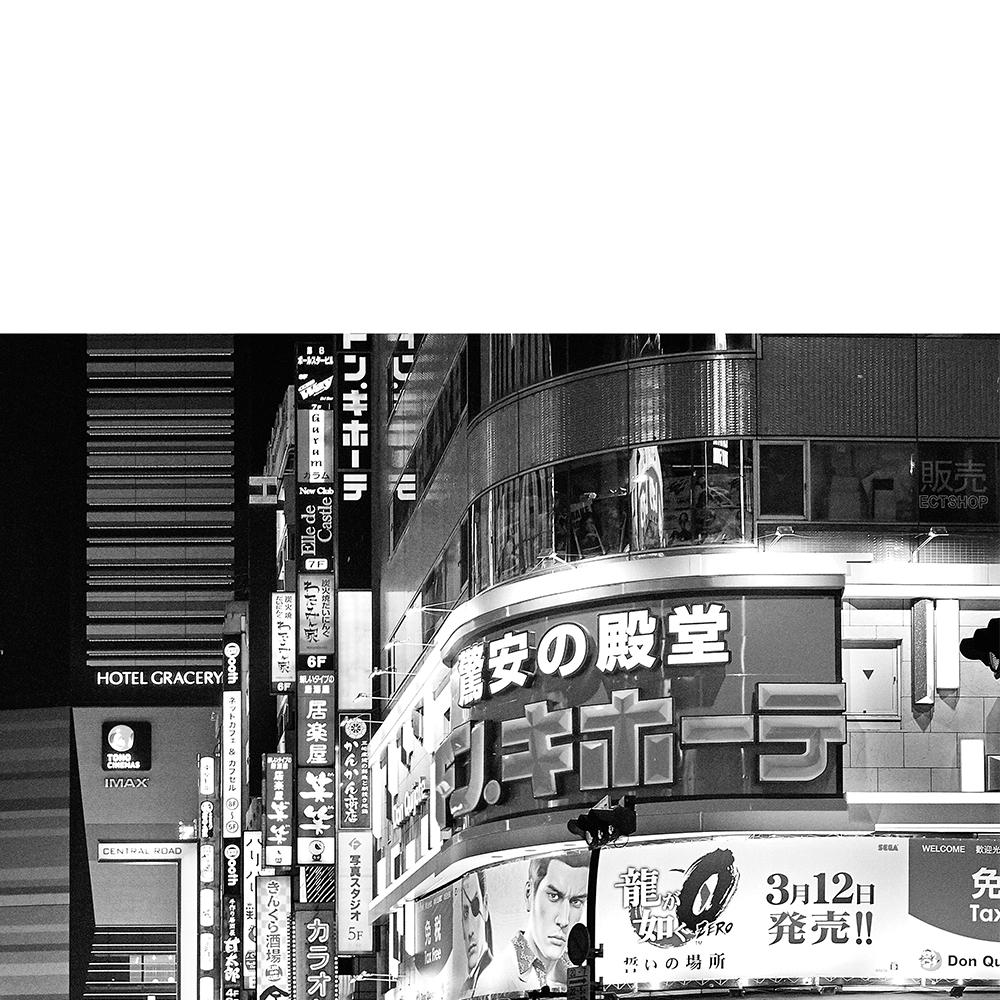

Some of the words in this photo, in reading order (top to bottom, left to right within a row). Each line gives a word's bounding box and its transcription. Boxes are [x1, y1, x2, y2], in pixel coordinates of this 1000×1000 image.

[301, 505, 316, 523] de
[317, 497, 333, 543] Castle
[301, 528, 316, 556] Elle
[307, 656, 327, 668] 6F
[457, 604, 729, 708] 驚安の殿堂
[97, 672, 149, 685] HOTEL
[151, 671, 224, 685] GRACERY
[277, 682, 291, 692] 6F
[307, 699, 328, 764] 居楽屋
[106, 753, 132, 761] TOHO
[104, 778, 144, 788] IMAX
[103, 847, 149, 856] CENTRAL
[154, 847, 182, 856] ROAD
[922, 845, 966, 853] WELCOME
[350, 855, 361, 921] 写真スタジオ
[613, 866, 682, 911] 龍が
[766, 871, 875, 907] 3月12日
[266, 880, 282, 963] きんくら酒場
[696, 921, 733, 939] ZERO
[769, 910, 873, 945] 発売!!
[348, 928, 363, 941] 5F
[948, 955, 977, 967] Don
[225, 988, 240, 997] 4F
